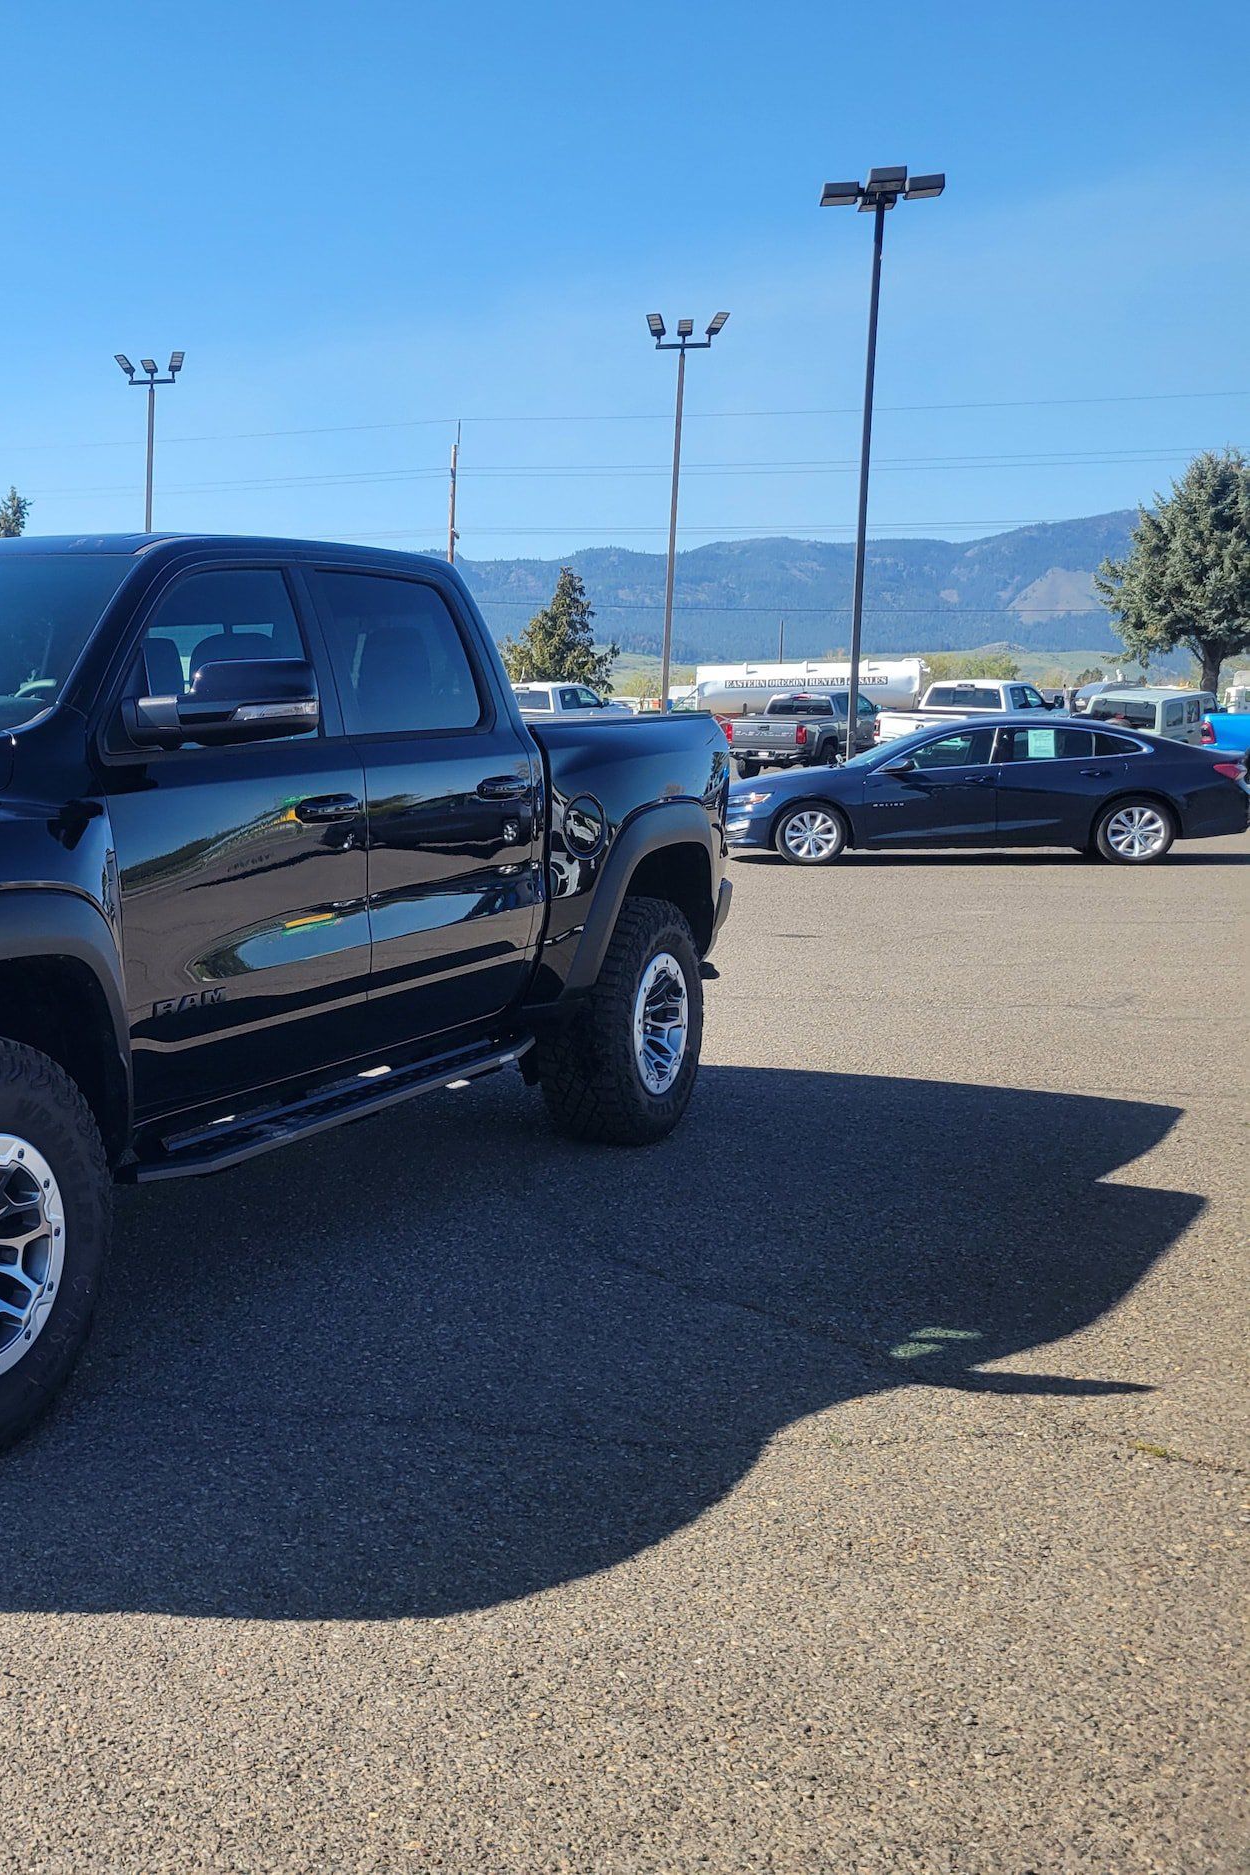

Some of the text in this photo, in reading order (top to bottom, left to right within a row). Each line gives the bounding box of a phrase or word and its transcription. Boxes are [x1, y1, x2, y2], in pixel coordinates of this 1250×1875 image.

[725, 680, 766, 688] EASTERN
[768, 678, 806, 687] OREGON
[808, 677, 845, 686] RENTAL
[858, 676, 888, 685] SALES
[152, 986, 227, 1018] RAM
